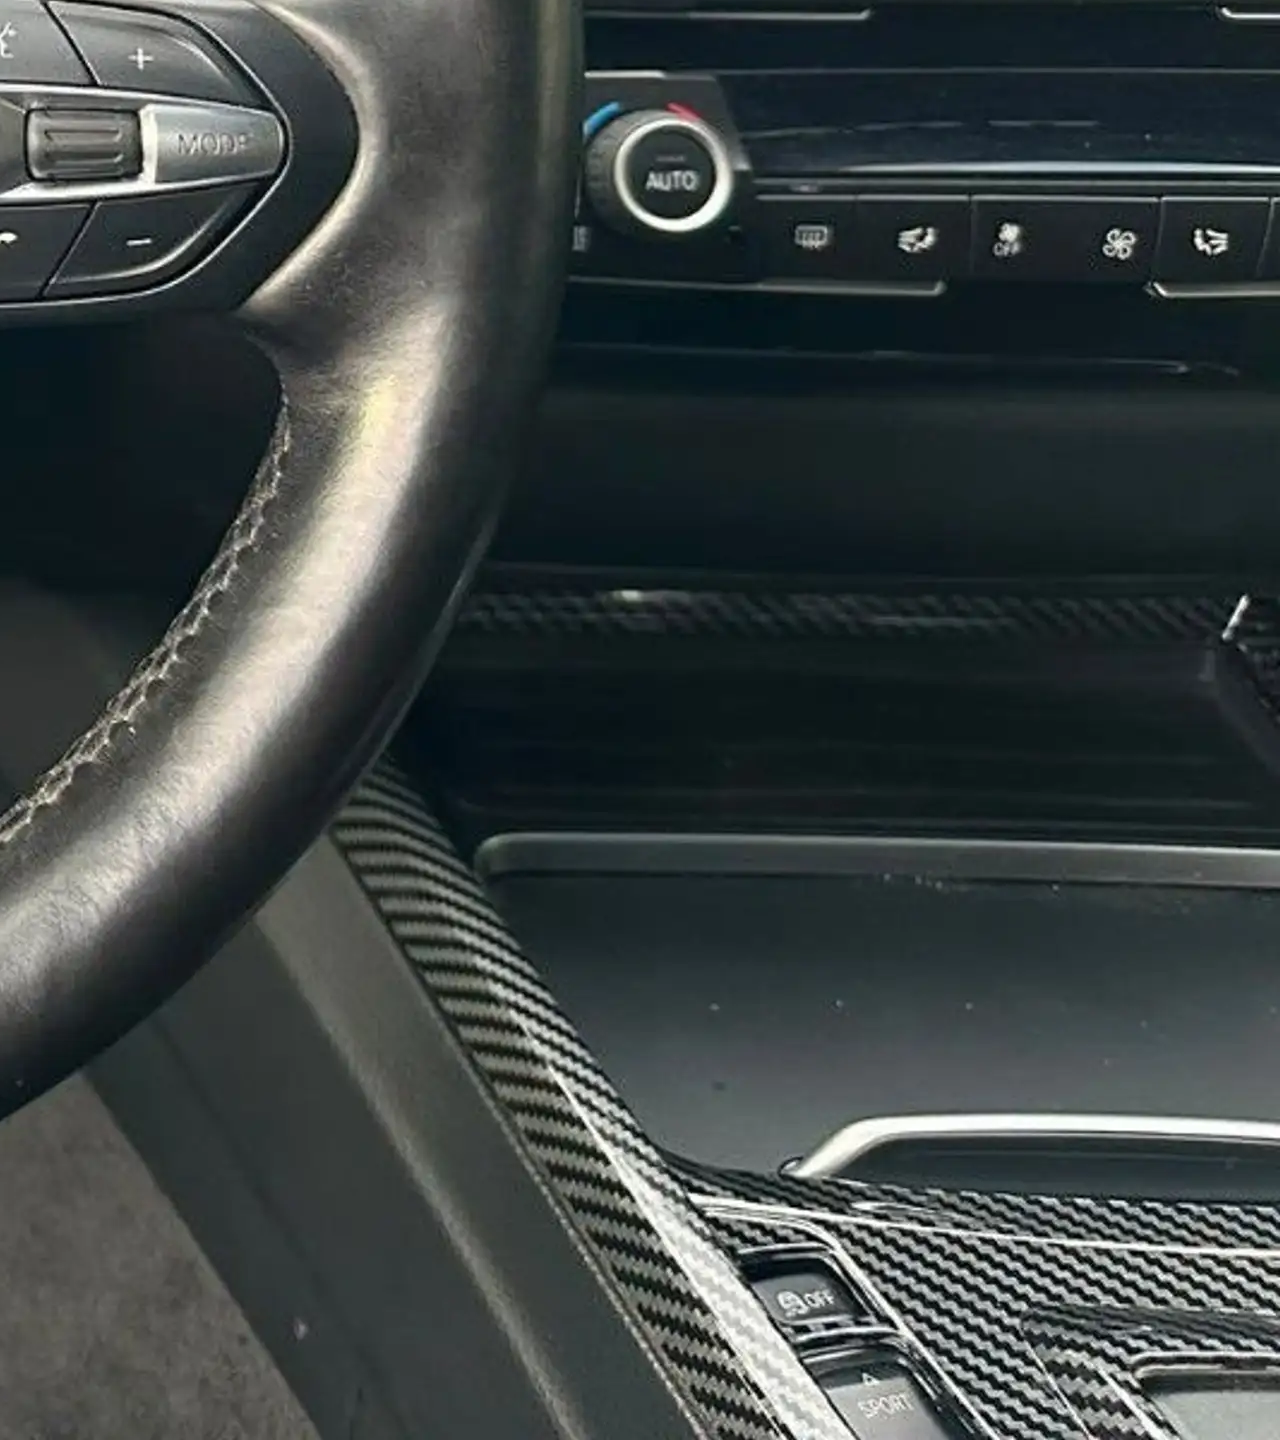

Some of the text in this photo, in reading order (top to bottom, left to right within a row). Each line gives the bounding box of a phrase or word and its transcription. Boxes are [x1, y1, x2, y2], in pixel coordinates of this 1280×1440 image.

[176, 131, 251, 157] MODE
[645, 169, 699, 192] AUTO
[804, 1289, 834, 1308] OFF
[857, 1392, 913, 1419] SPORT
